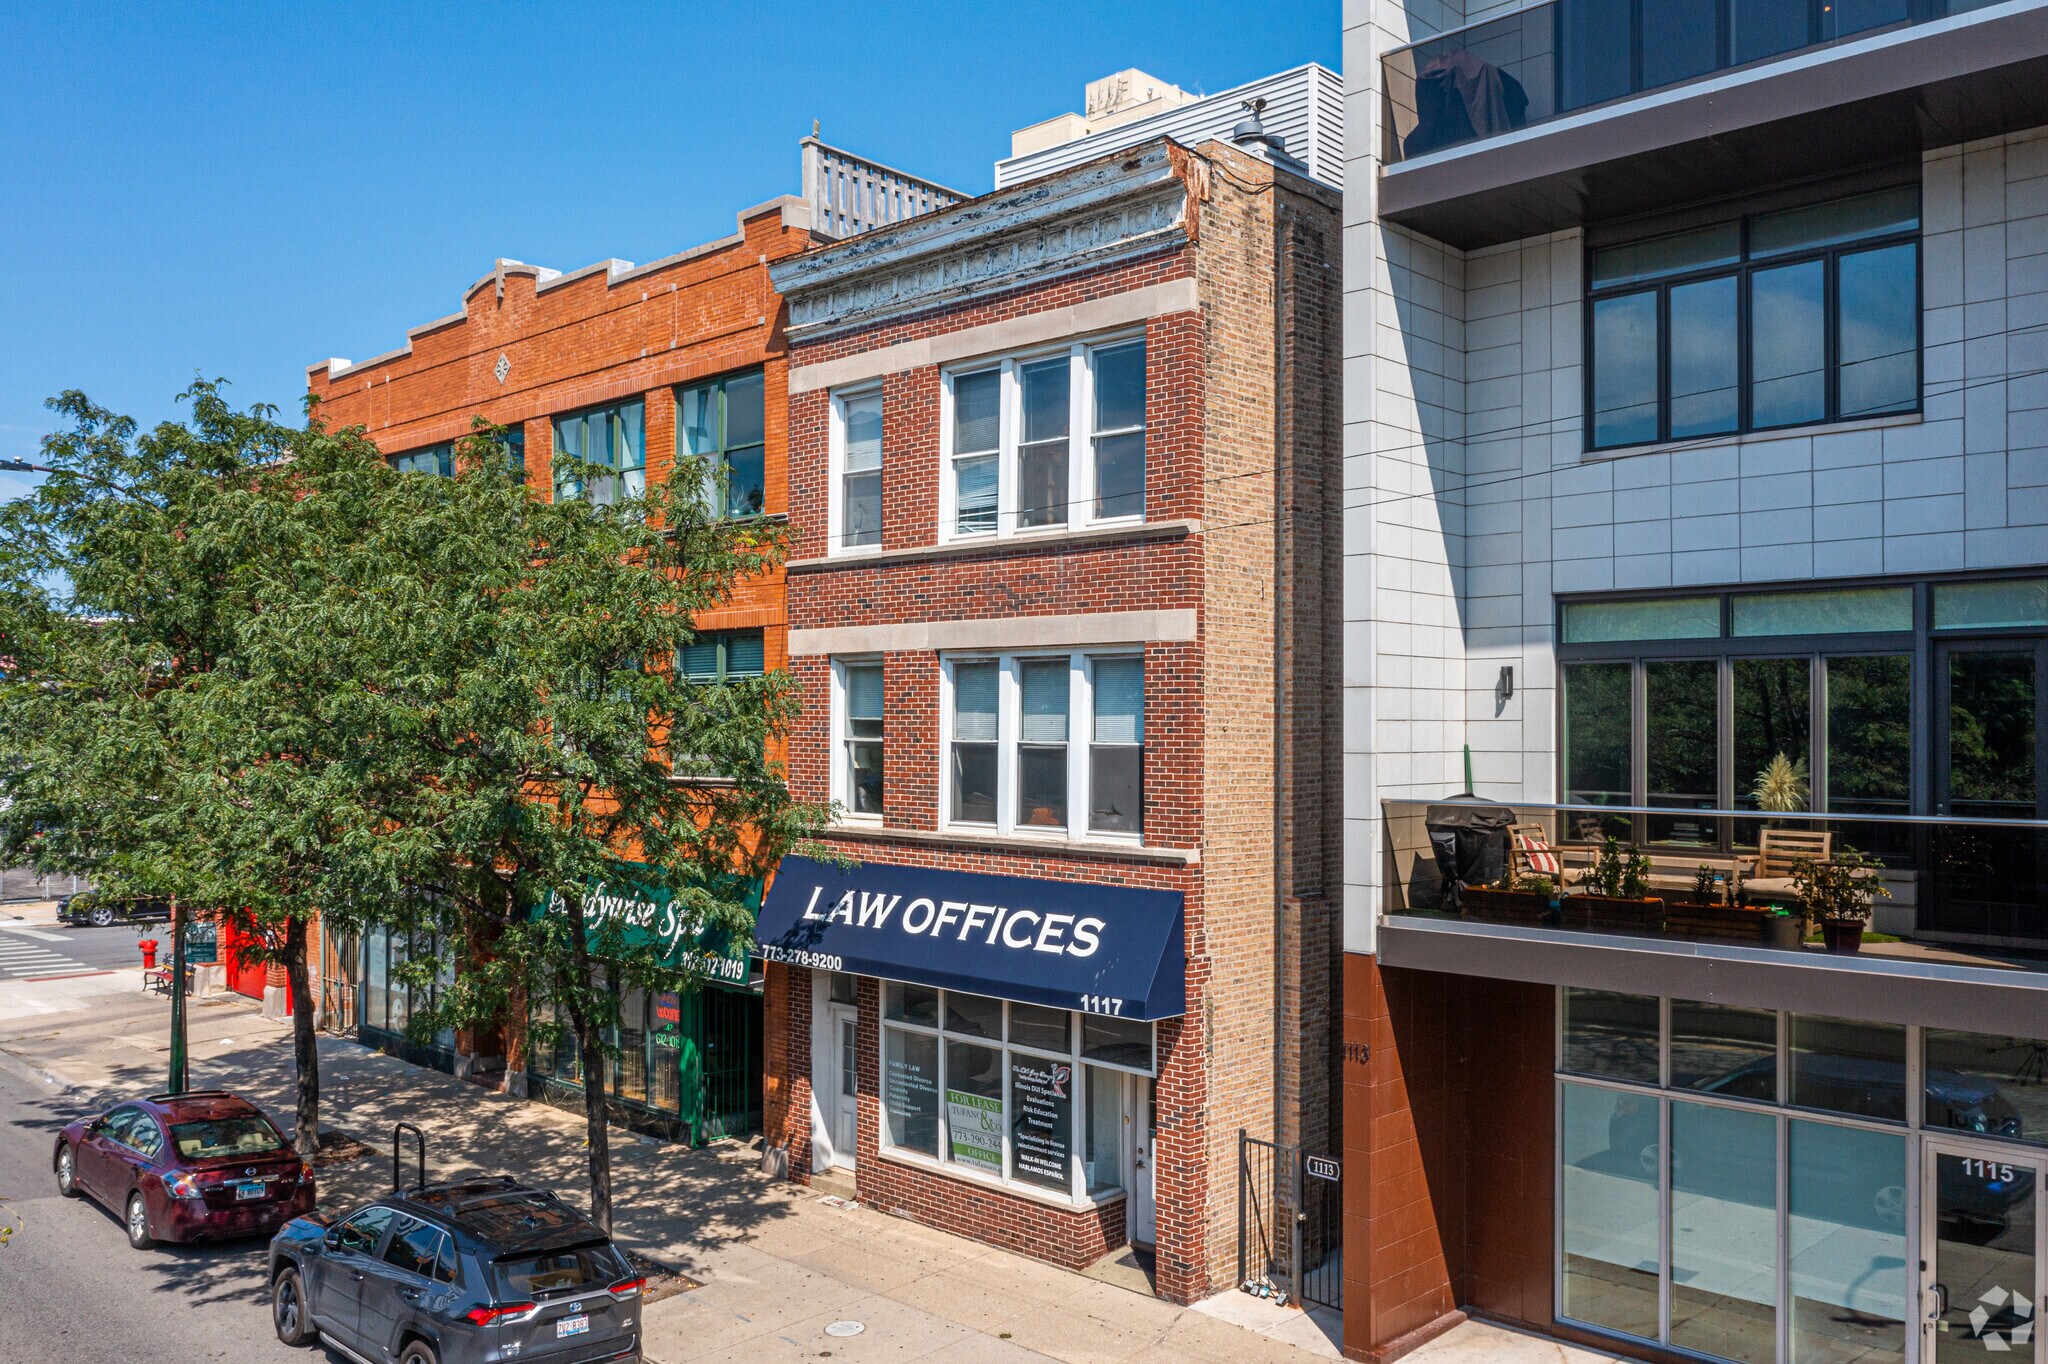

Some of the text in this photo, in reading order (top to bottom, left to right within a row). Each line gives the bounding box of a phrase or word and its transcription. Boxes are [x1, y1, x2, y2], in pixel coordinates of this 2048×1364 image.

[803, 886, 1106, 957] LAW OFFICES
[762, 944, 842, 971] 773-278-9200
[1081, 994, 1122, 1016] 1117
[889, 1060, 920, 1072] FAMILY LAW
[914, 1075, 932, 1085] Divorce
[1015, 1081, 1030, 1091] Illinois
[1031, 1085, 1041, 1093] DUI
[920, 1085, 938, 1094] Divorce
[951, 1092, 1000, 1112] FOR LEASE
[1026, 1094, 1055, 1107] Evaluations
[952, 1106, 985, 1119] TUFANO
[1023, 1104, 1058, 1119] Risk Education
[1027, 1117, 1053, 1129] Treatment
[967, 1147, 997, 1162] OFFICE
[1048, 1149, 1065, 1159] services
[1020, 1154, 1062, 1170] WALK-IN WELCOME
[1313, 1161, 1334, 1176] 1113
[1018, 1162, 1064, 1180] HABLAMOS ESPAÑOL
[1962, 1158, 2014, 1182] 1115
